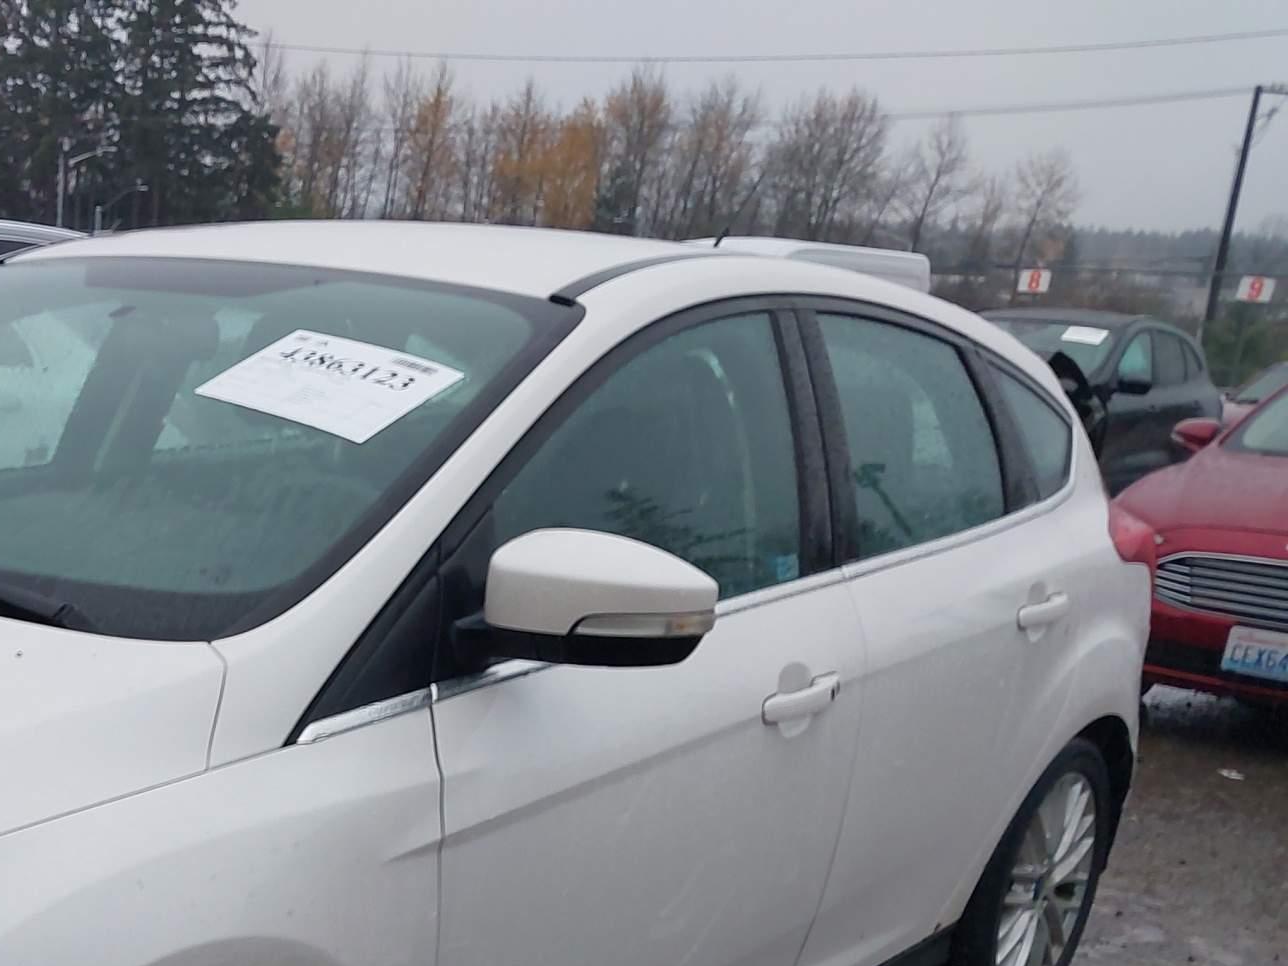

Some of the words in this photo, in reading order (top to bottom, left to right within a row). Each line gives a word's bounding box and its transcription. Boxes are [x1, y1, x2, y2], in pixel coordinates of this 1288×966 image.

[1027, 270, 1041, 293] 8
[1247, 276, 1264, 301] 9
[279, 345, 417, 392] 43863123
